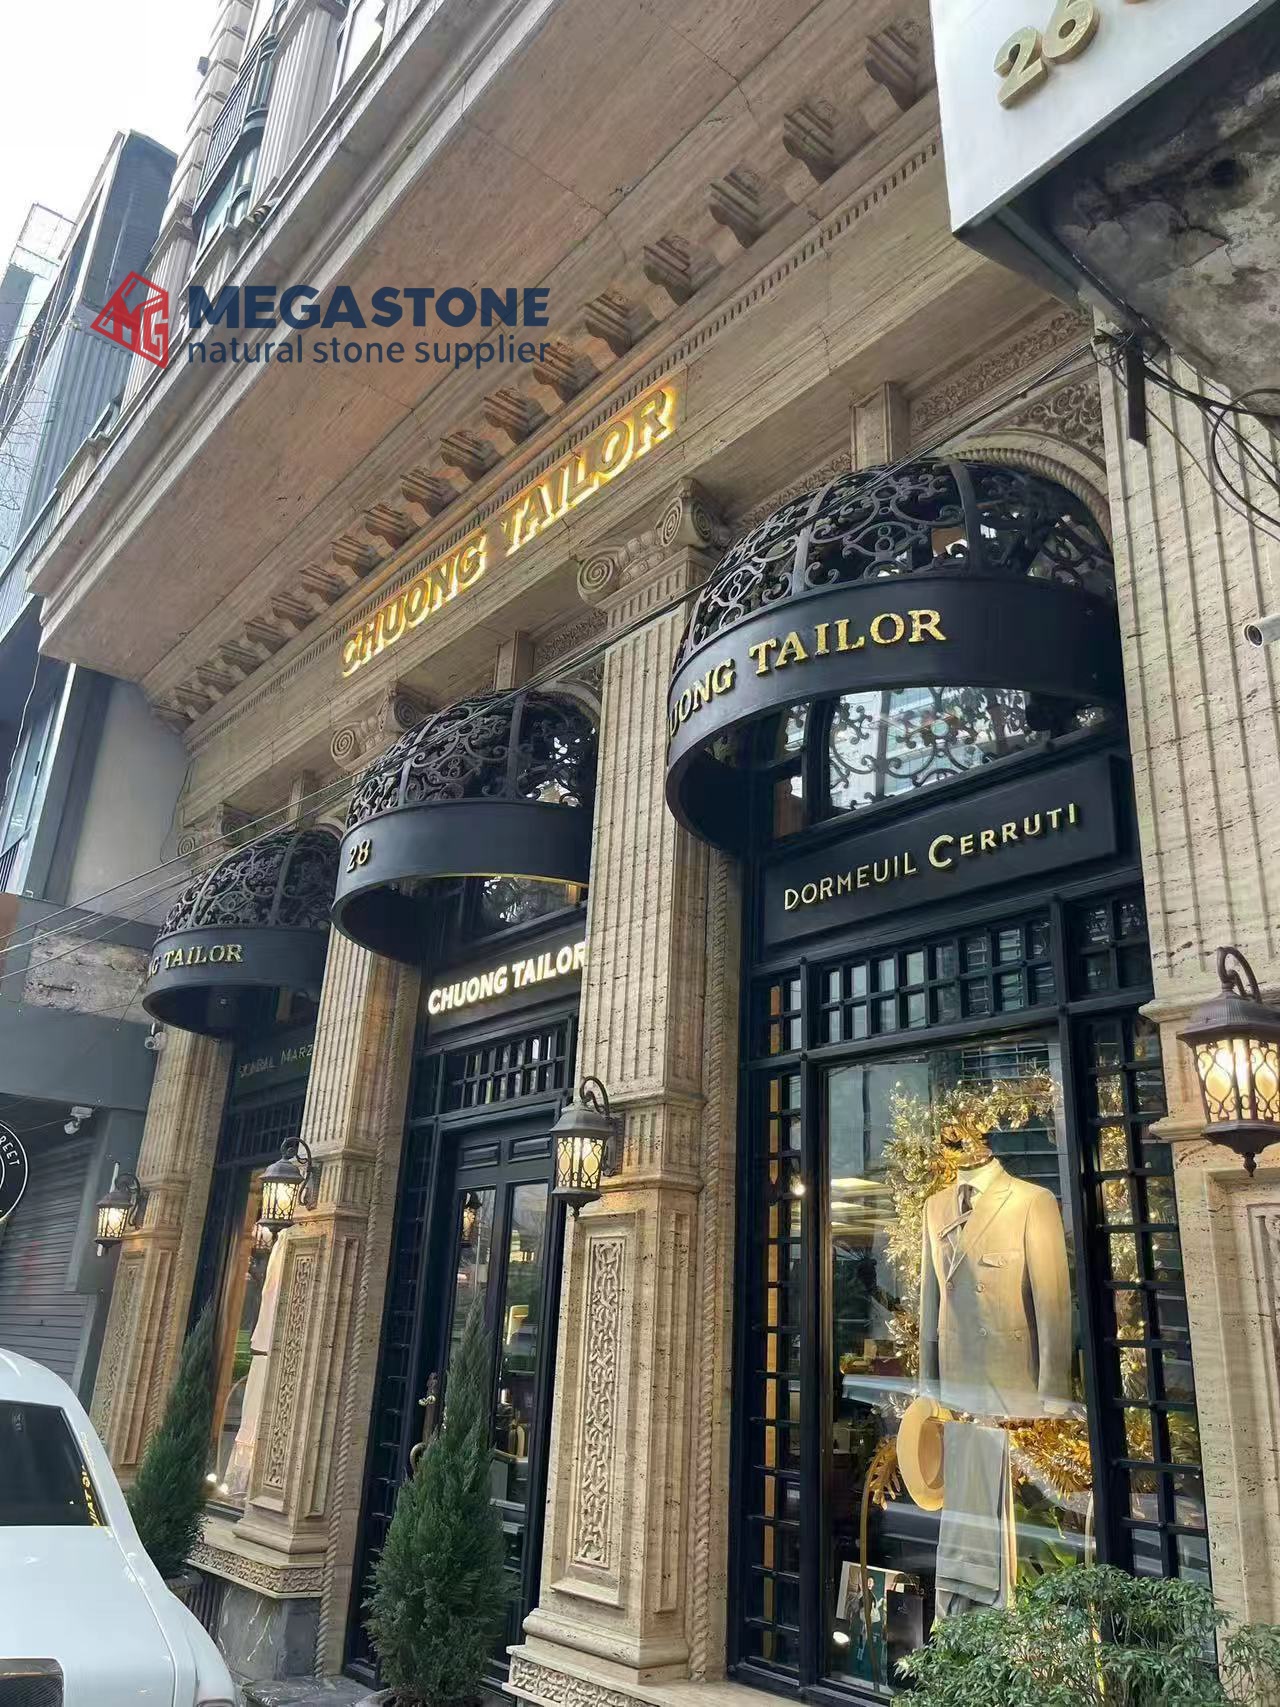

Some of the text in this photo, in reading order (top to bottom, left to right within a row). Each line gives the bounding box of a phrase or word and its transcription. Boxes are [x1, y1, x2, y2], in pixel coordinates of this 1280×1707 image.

[342, 389, 675, 677] CHUONG TAILOR
[750, 609, 947, 676] TAILOR
[346, 839, 371, 872] 28
[784, 803, 1077, 911] DORMEUIL CERRUTI
[164, 944, 243, 970] TAILOR
[428, 966, 508, 1015] CHUONG
